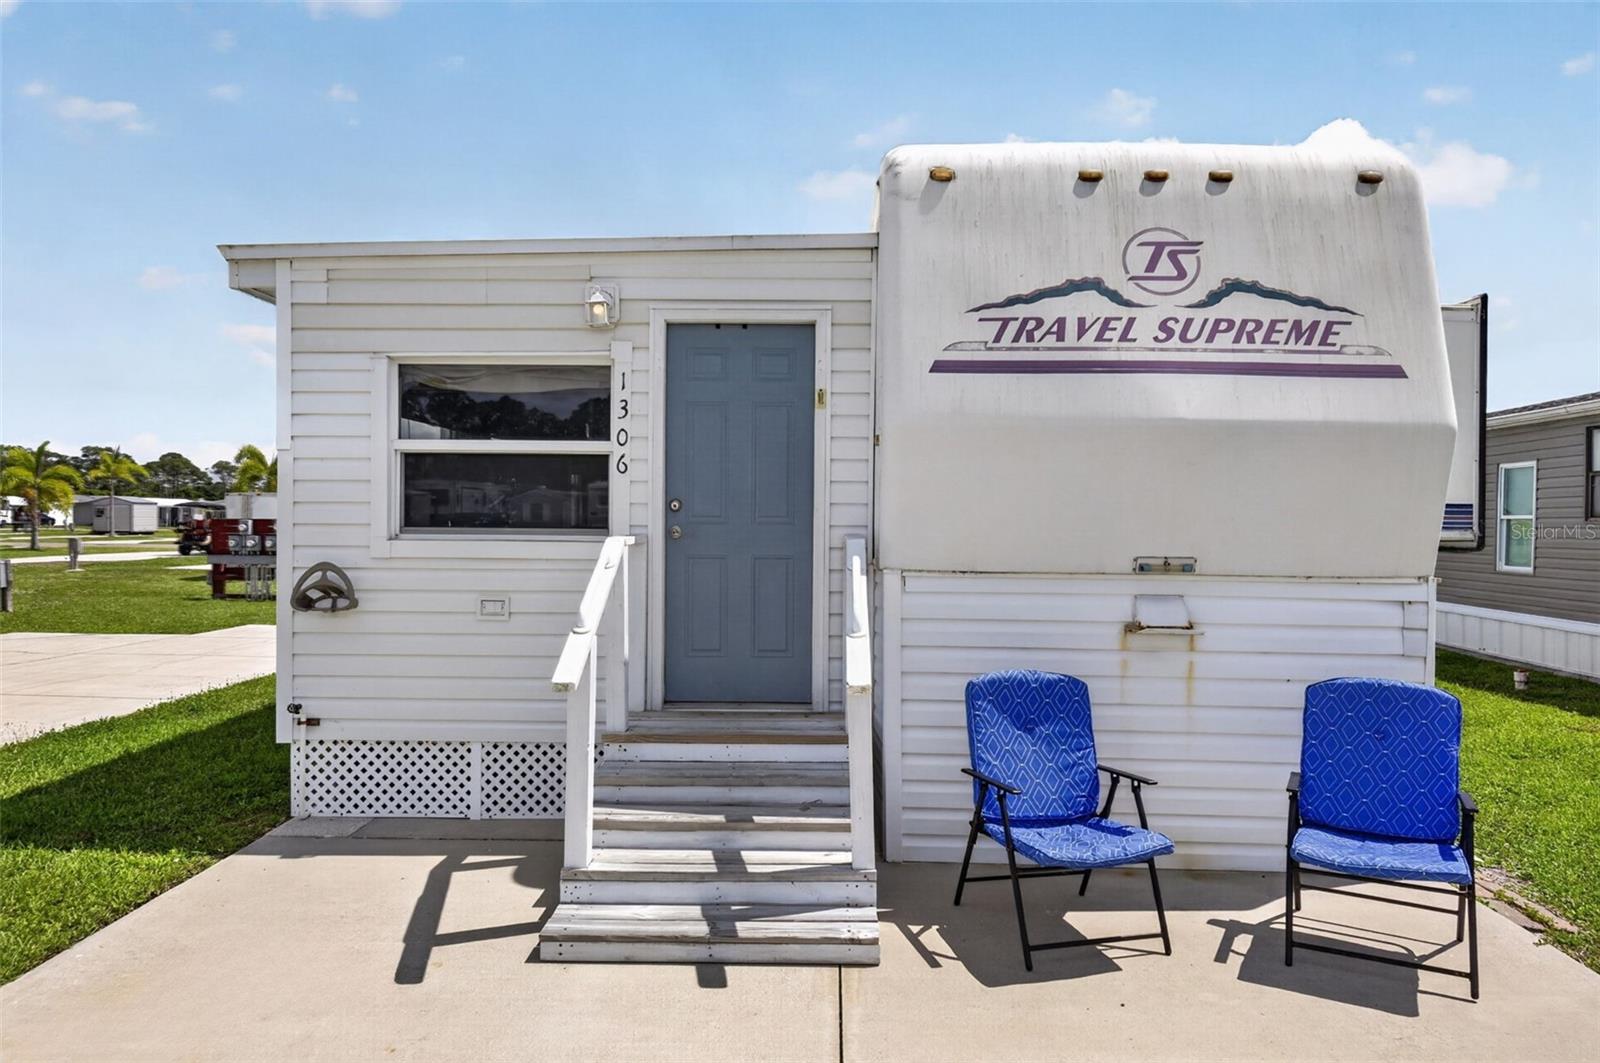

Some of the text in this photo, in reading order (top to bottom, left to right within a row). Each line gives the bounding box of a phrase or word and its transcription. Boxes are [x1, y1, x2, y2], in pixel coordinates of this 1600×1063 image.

[1128, 240, 1204, 282] TS
[977, 316, 1352, 348] TRAVEL SUPREME
[616, 371, 629, 475] 1306
